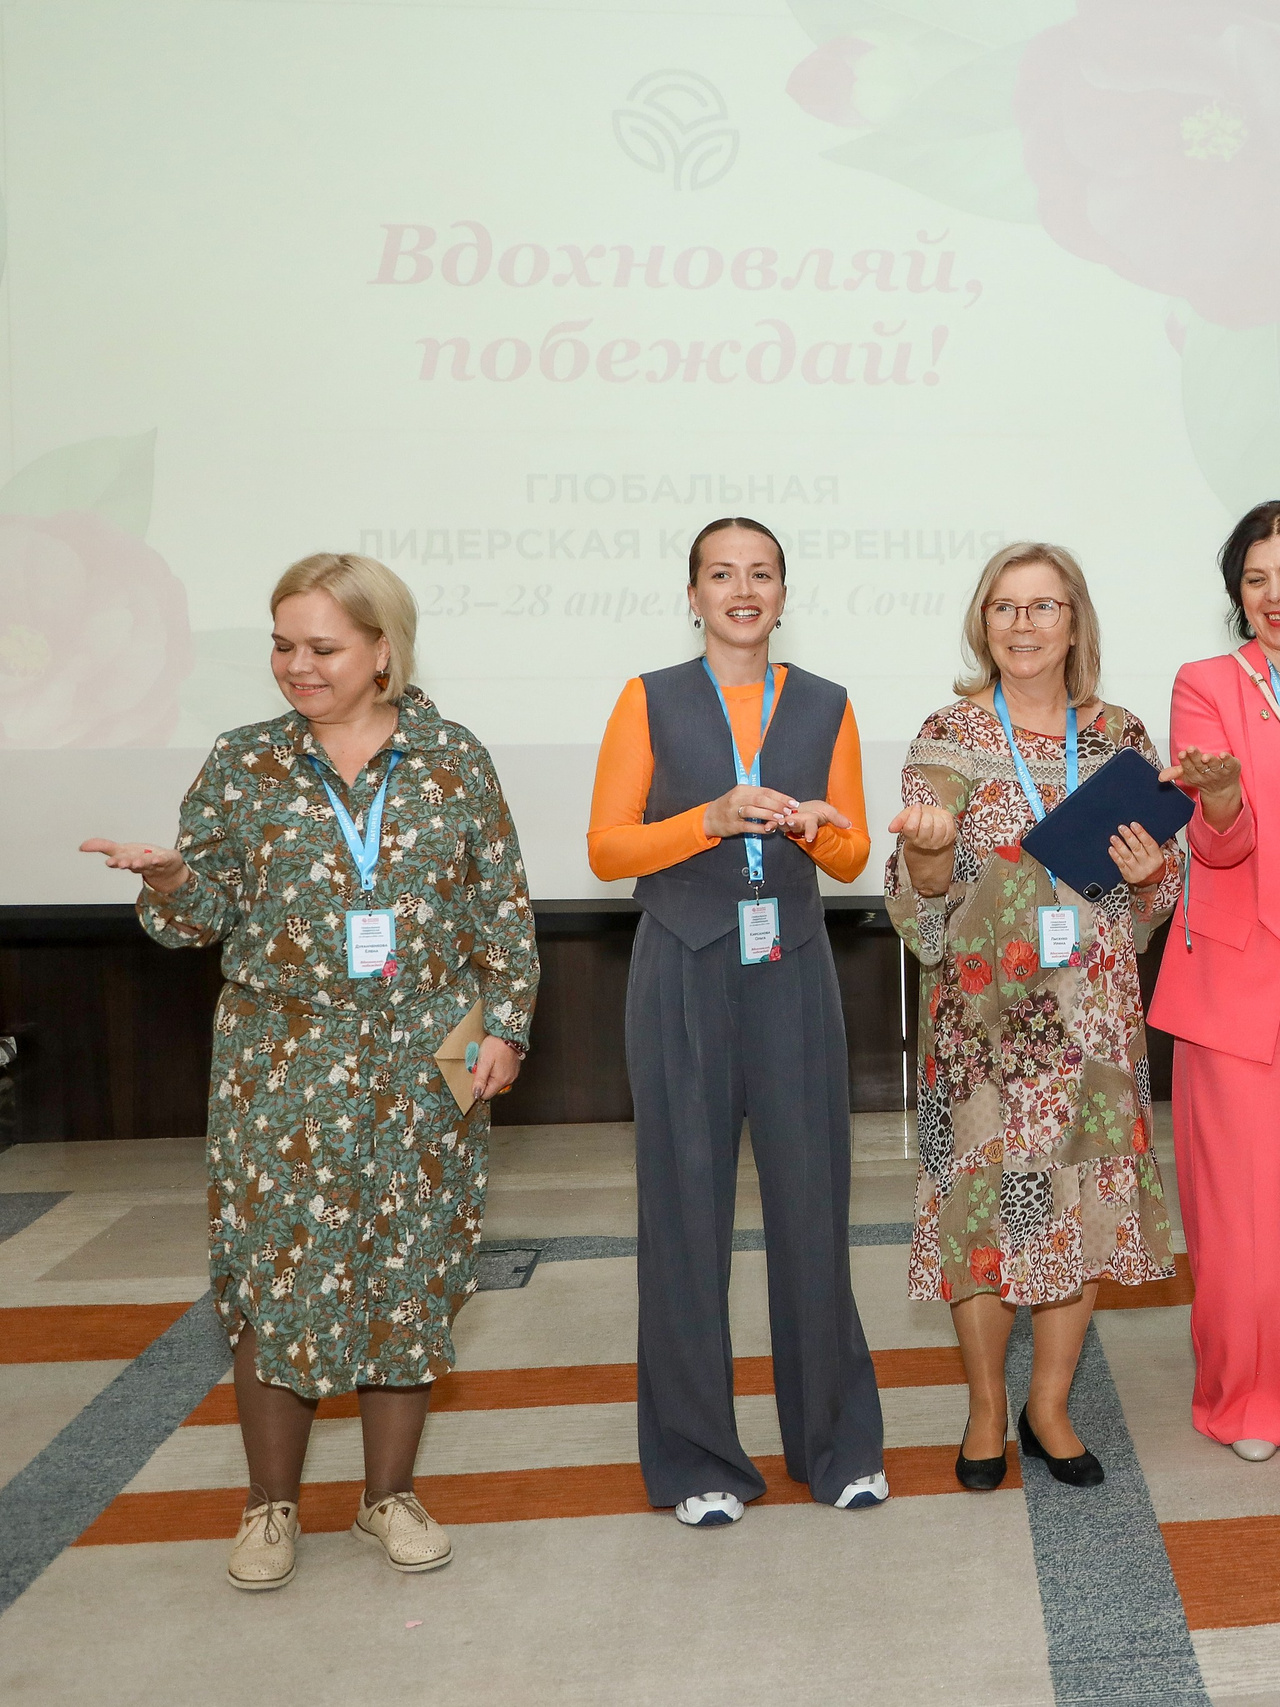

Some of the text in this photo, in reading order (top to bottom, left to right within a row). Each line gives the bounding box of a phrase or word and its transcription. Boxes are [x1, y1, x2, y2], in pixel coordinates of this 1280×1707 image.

[366, 219, 984, 310] Вдохновляй,
[414, 317, 950, 388] побеждай!
[525, 473, 840, 505] ГЛОБАЛЬНАЯ
[845, 583, 946, 618] Сочи
